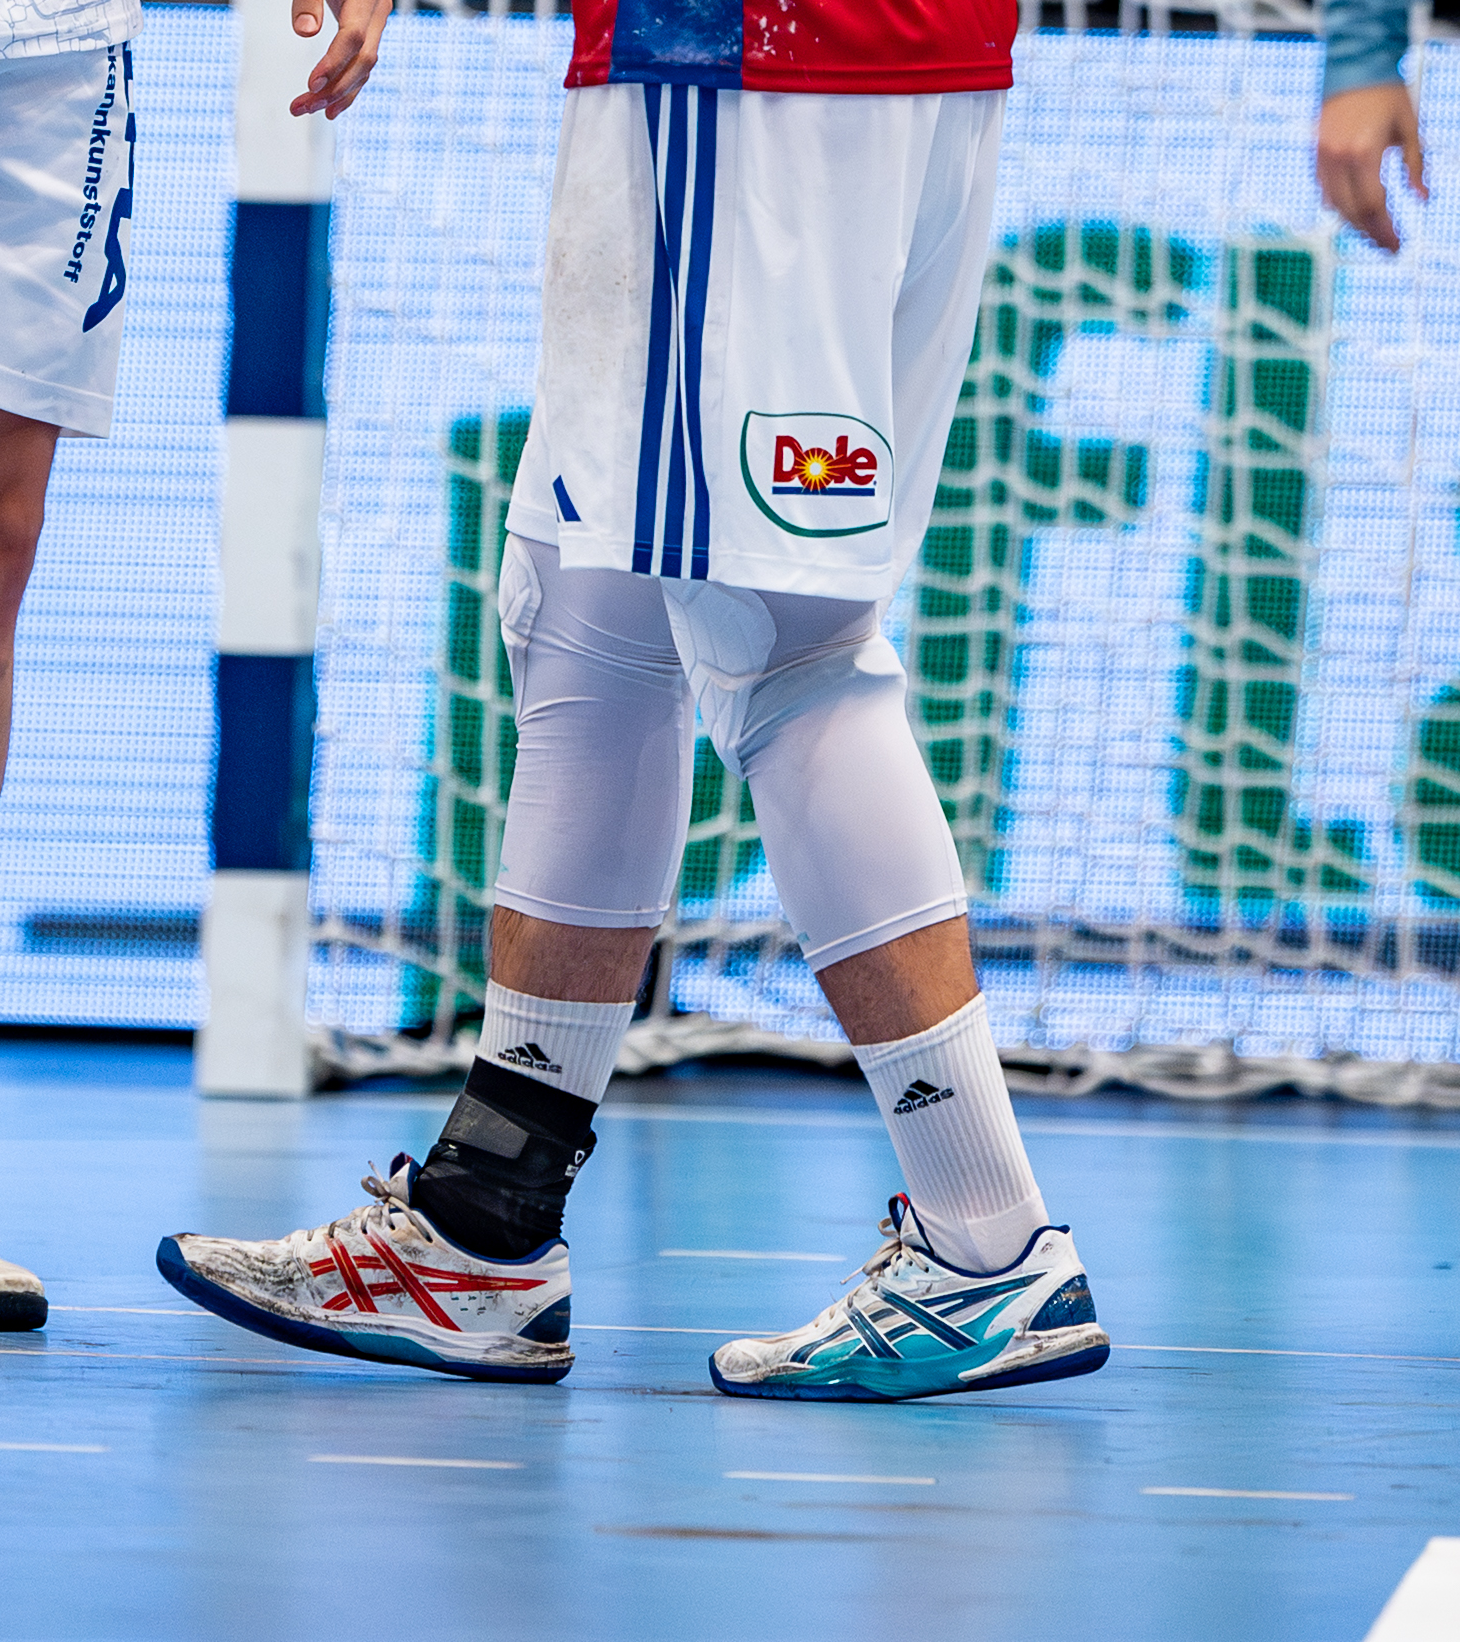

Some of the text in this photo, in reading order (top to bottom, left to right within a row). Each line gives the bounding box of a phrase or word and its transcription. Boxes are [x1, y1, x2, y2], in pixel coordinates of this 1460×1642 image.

[772, 434, 879, 491] Dole
[497, 1051, 563, 1075] adidas
[893, 1087, 955, 1116] adidas
